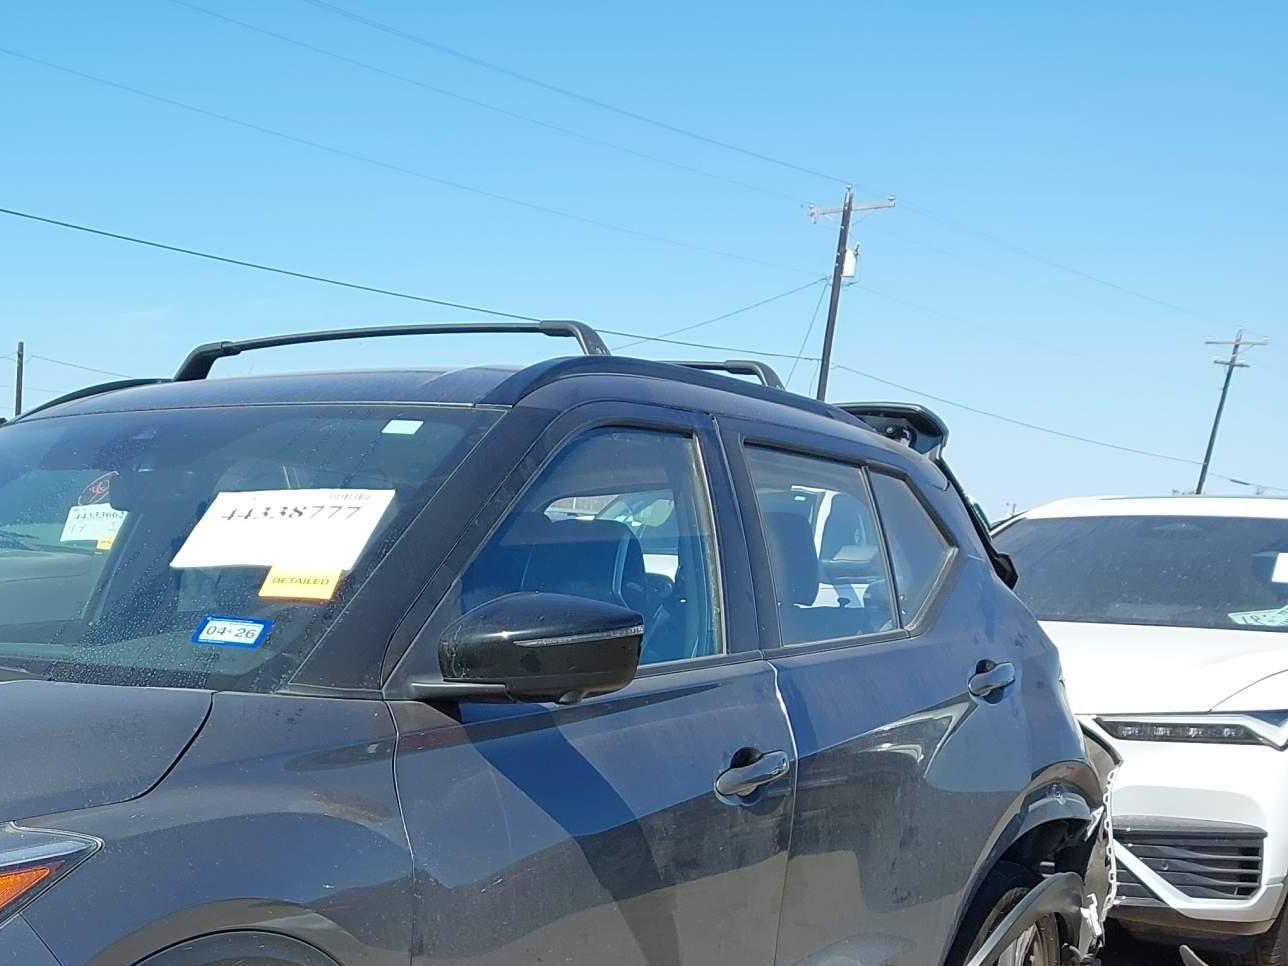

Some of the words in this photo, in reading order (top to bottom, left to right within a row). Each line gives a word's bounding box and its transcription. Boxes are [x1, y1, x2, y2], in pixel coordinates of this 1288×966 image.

[219, 504, 362, 522] 44338777
[271, 575, 331, 587] DETAILED
[206, 625, 227, 636] 04
[234, 627, 258, 639] 26
